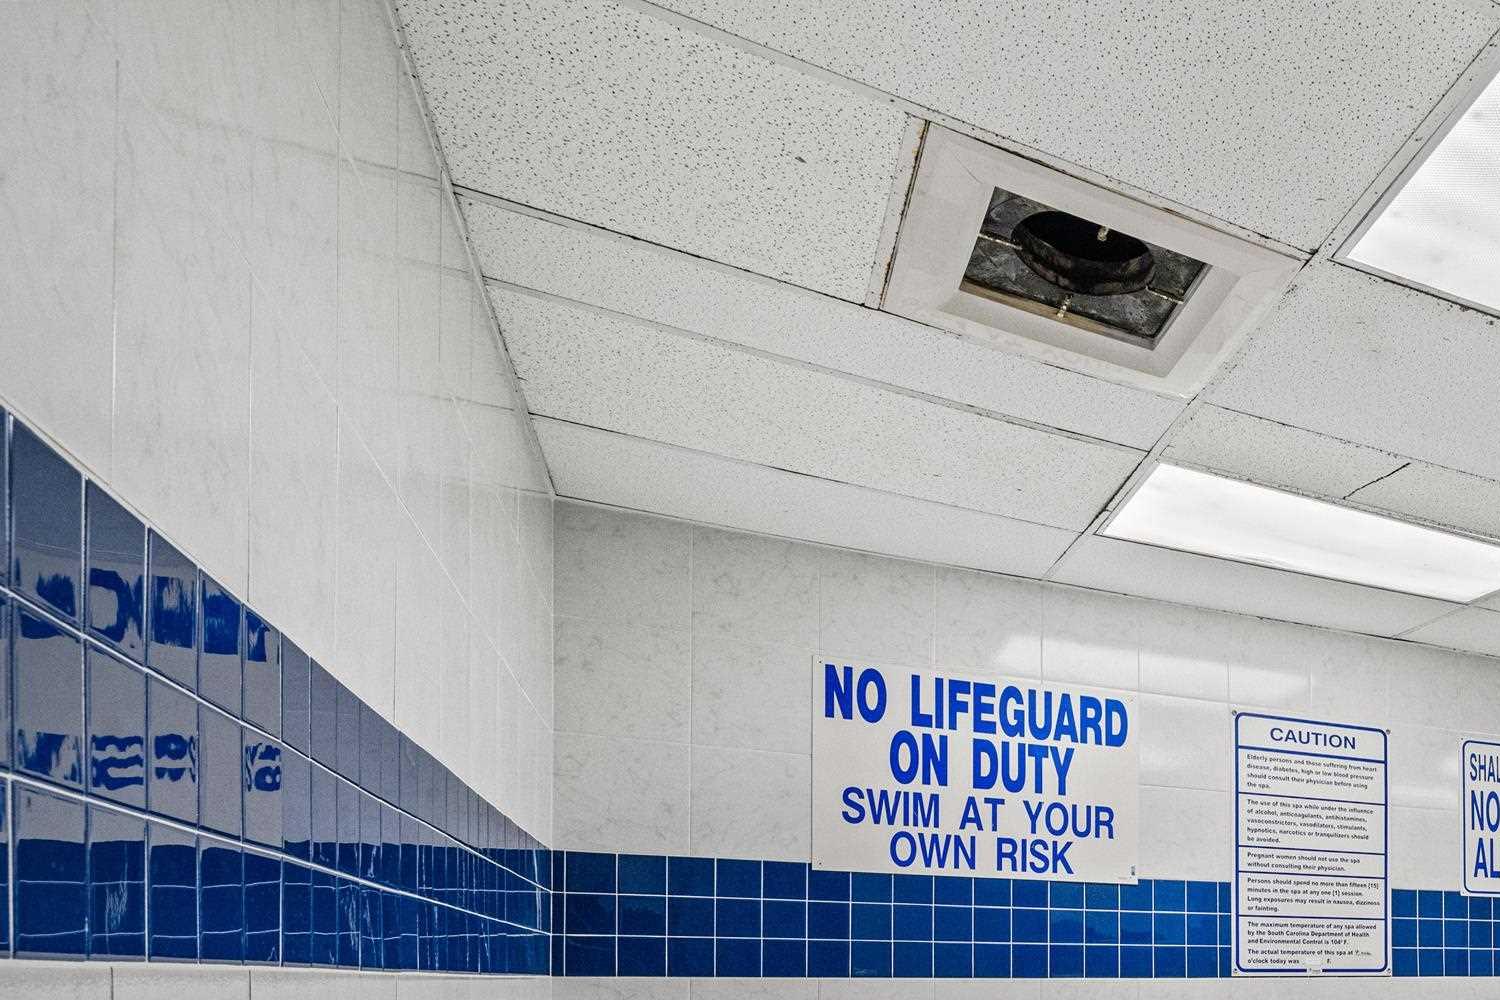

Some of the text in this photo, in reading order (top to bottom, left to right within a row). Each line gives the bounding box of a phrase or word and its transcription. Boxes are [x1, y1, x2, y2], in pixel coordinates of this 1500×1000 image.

[825, 664, 1128, 748] NO LIFEGUARD
[1270, 728, 1356, 749] CAUTION
[889, 730, 1075, 796] ON DUTY
[841, 786, 1115, 840] SWIM AT YOUR
[1471, 790, 1500, 833] NO
[890, 831, 1074, 874] OWN RISK
